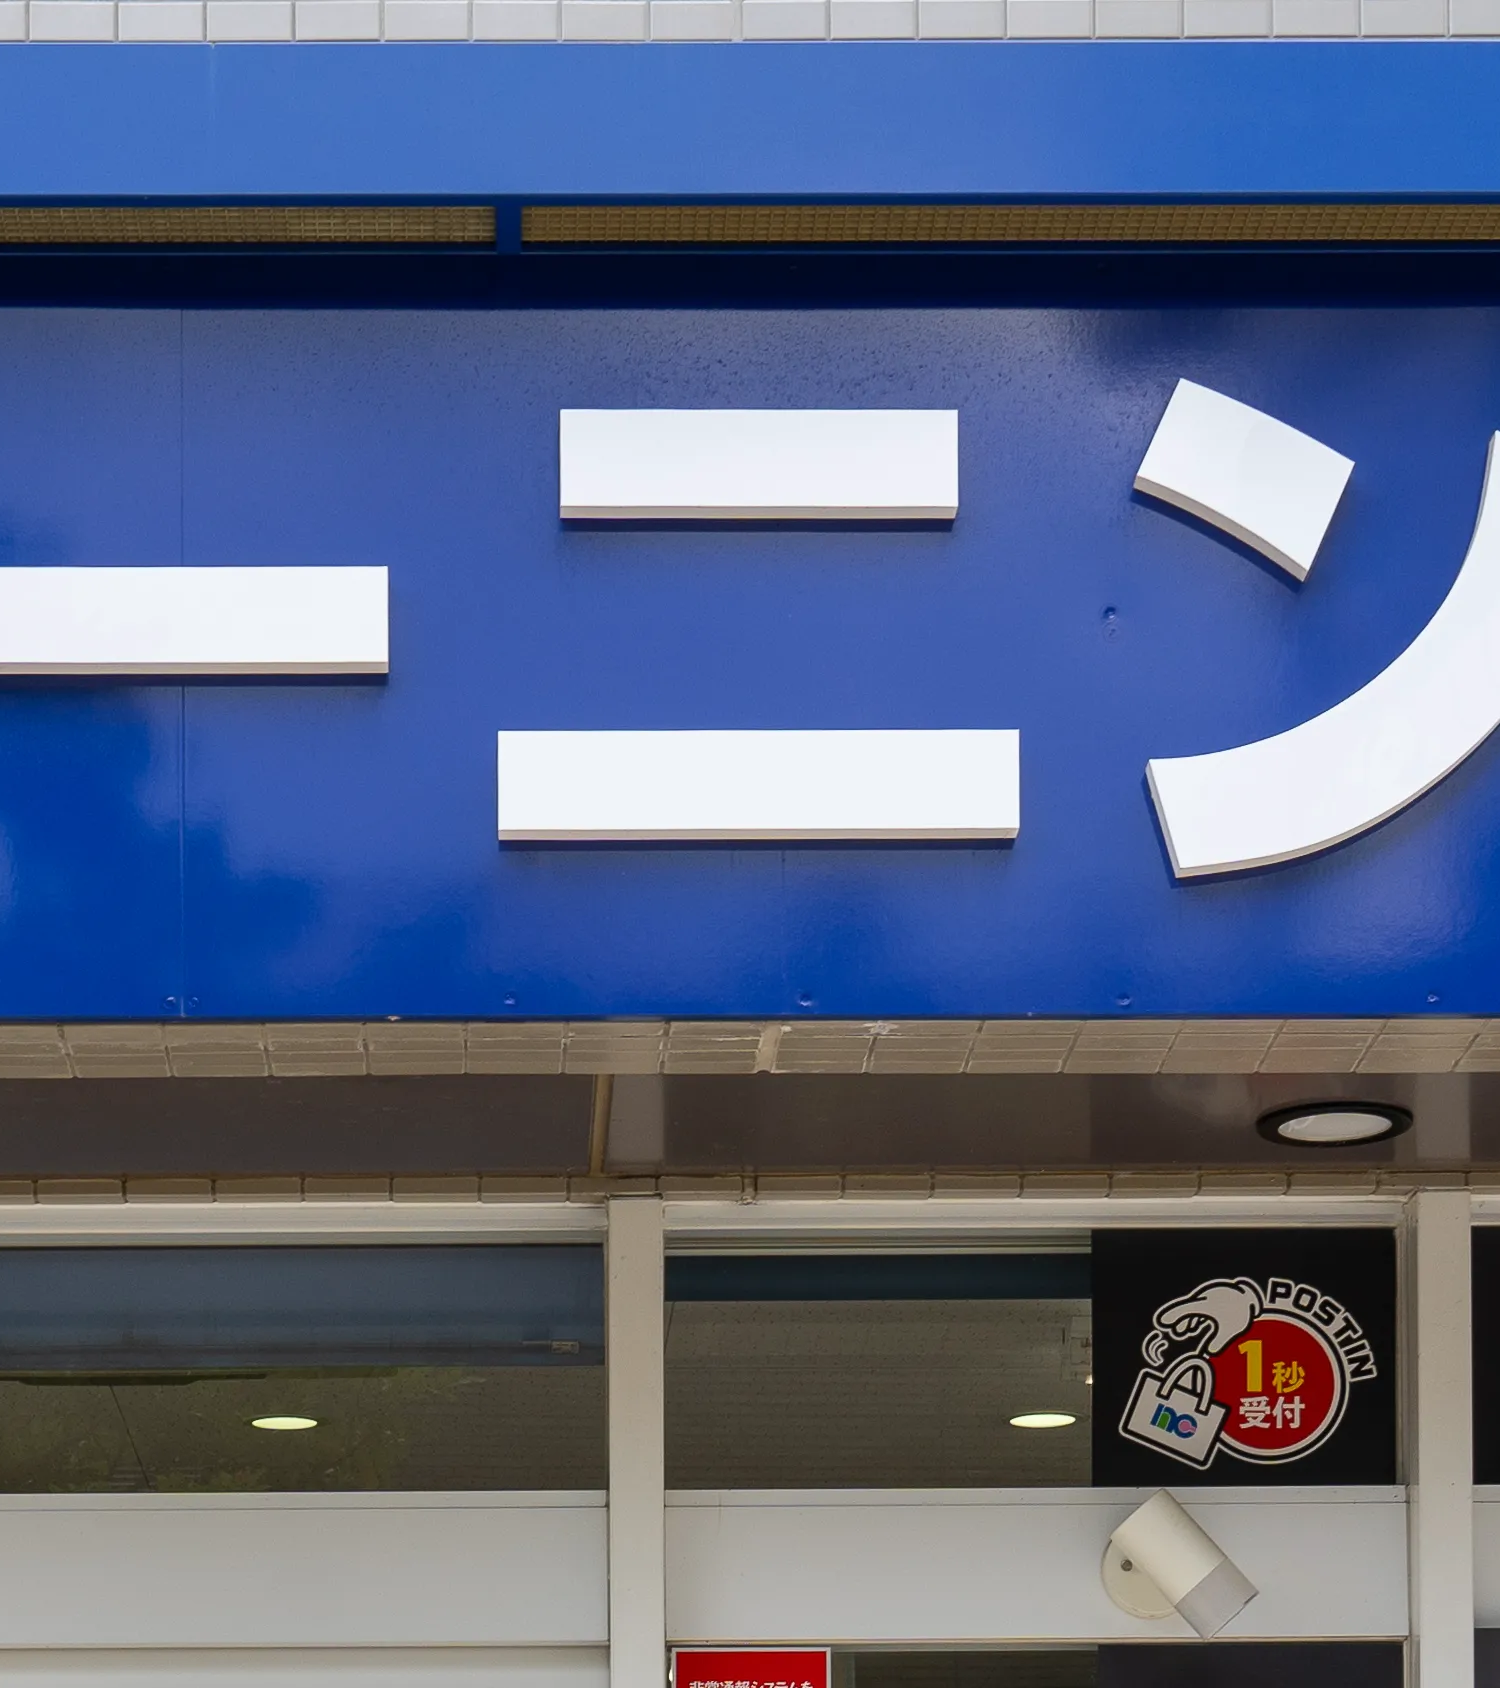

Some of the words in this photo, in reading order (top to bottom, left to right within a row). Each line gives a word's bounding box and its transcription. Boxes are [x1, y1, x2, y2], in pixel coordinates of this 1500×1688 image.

[1269, 1280, 1361, 1339] POST
[1238, 1340, 1305, 1393] 1秒
[1239, 1396, 1305, 1429] 受付
